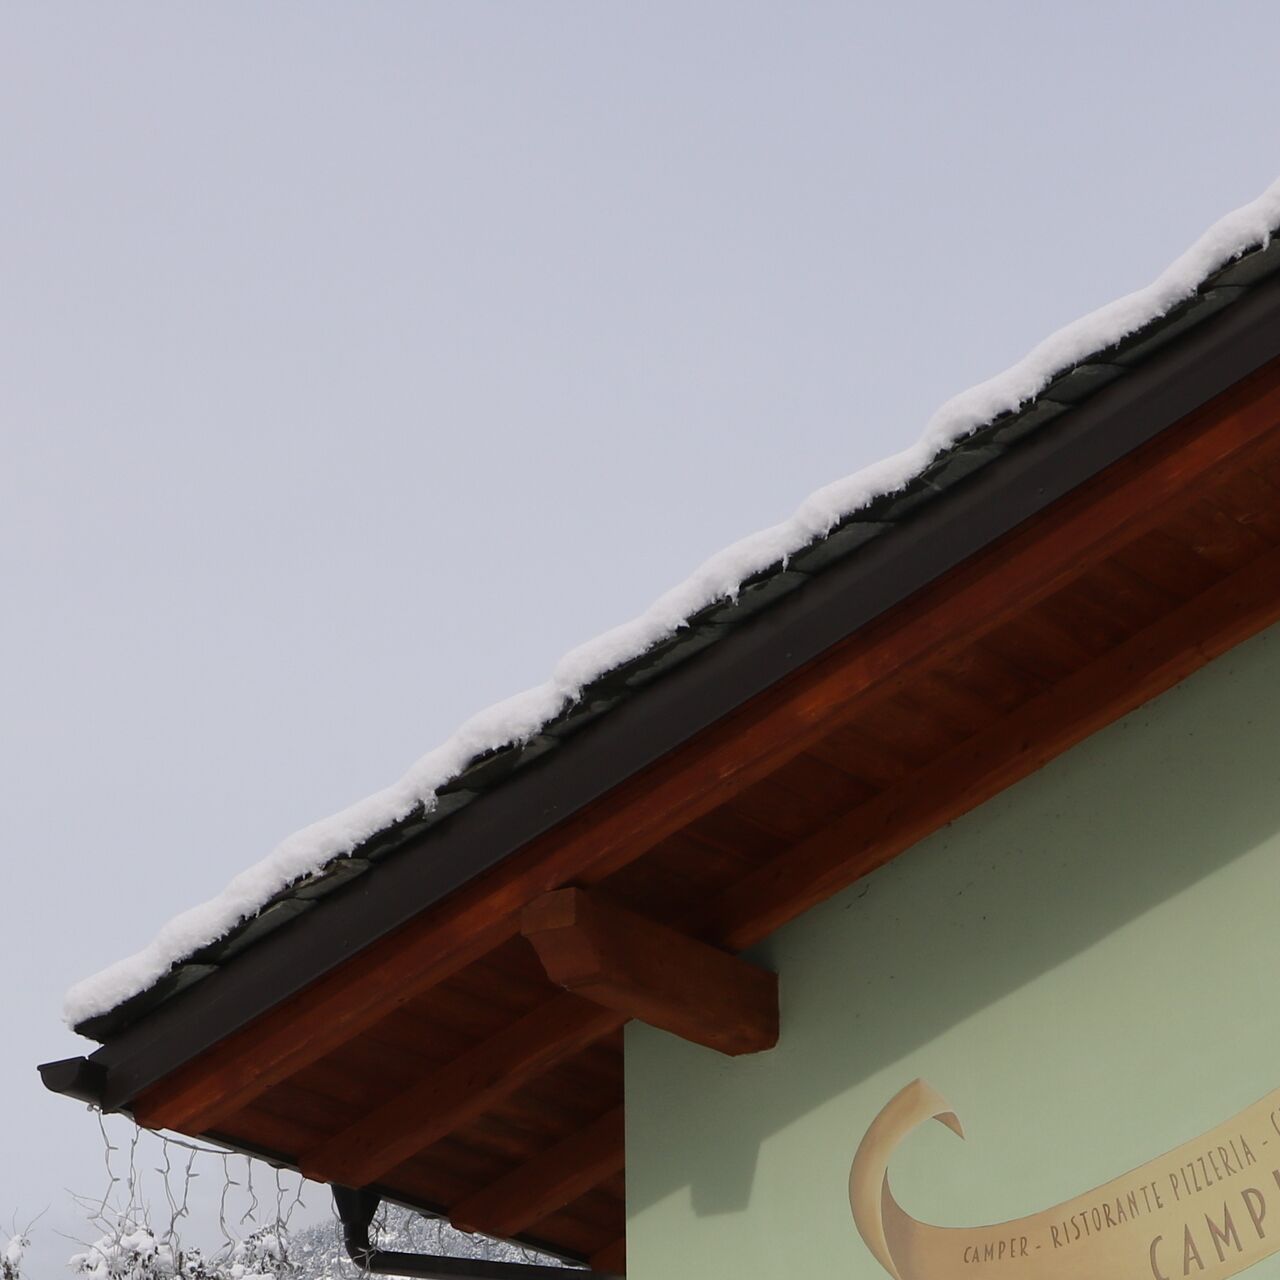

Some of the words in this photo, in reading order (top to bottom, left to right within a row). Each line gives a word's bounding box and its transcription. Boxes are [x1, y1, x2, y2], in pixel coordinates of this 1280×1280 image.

[963, 1236, 1029, 1264] CAMPER
[1049, 1181, 1164, 1249] RISTORANTE
[1169, 1134, 1257, 1201] PIZZERIA
